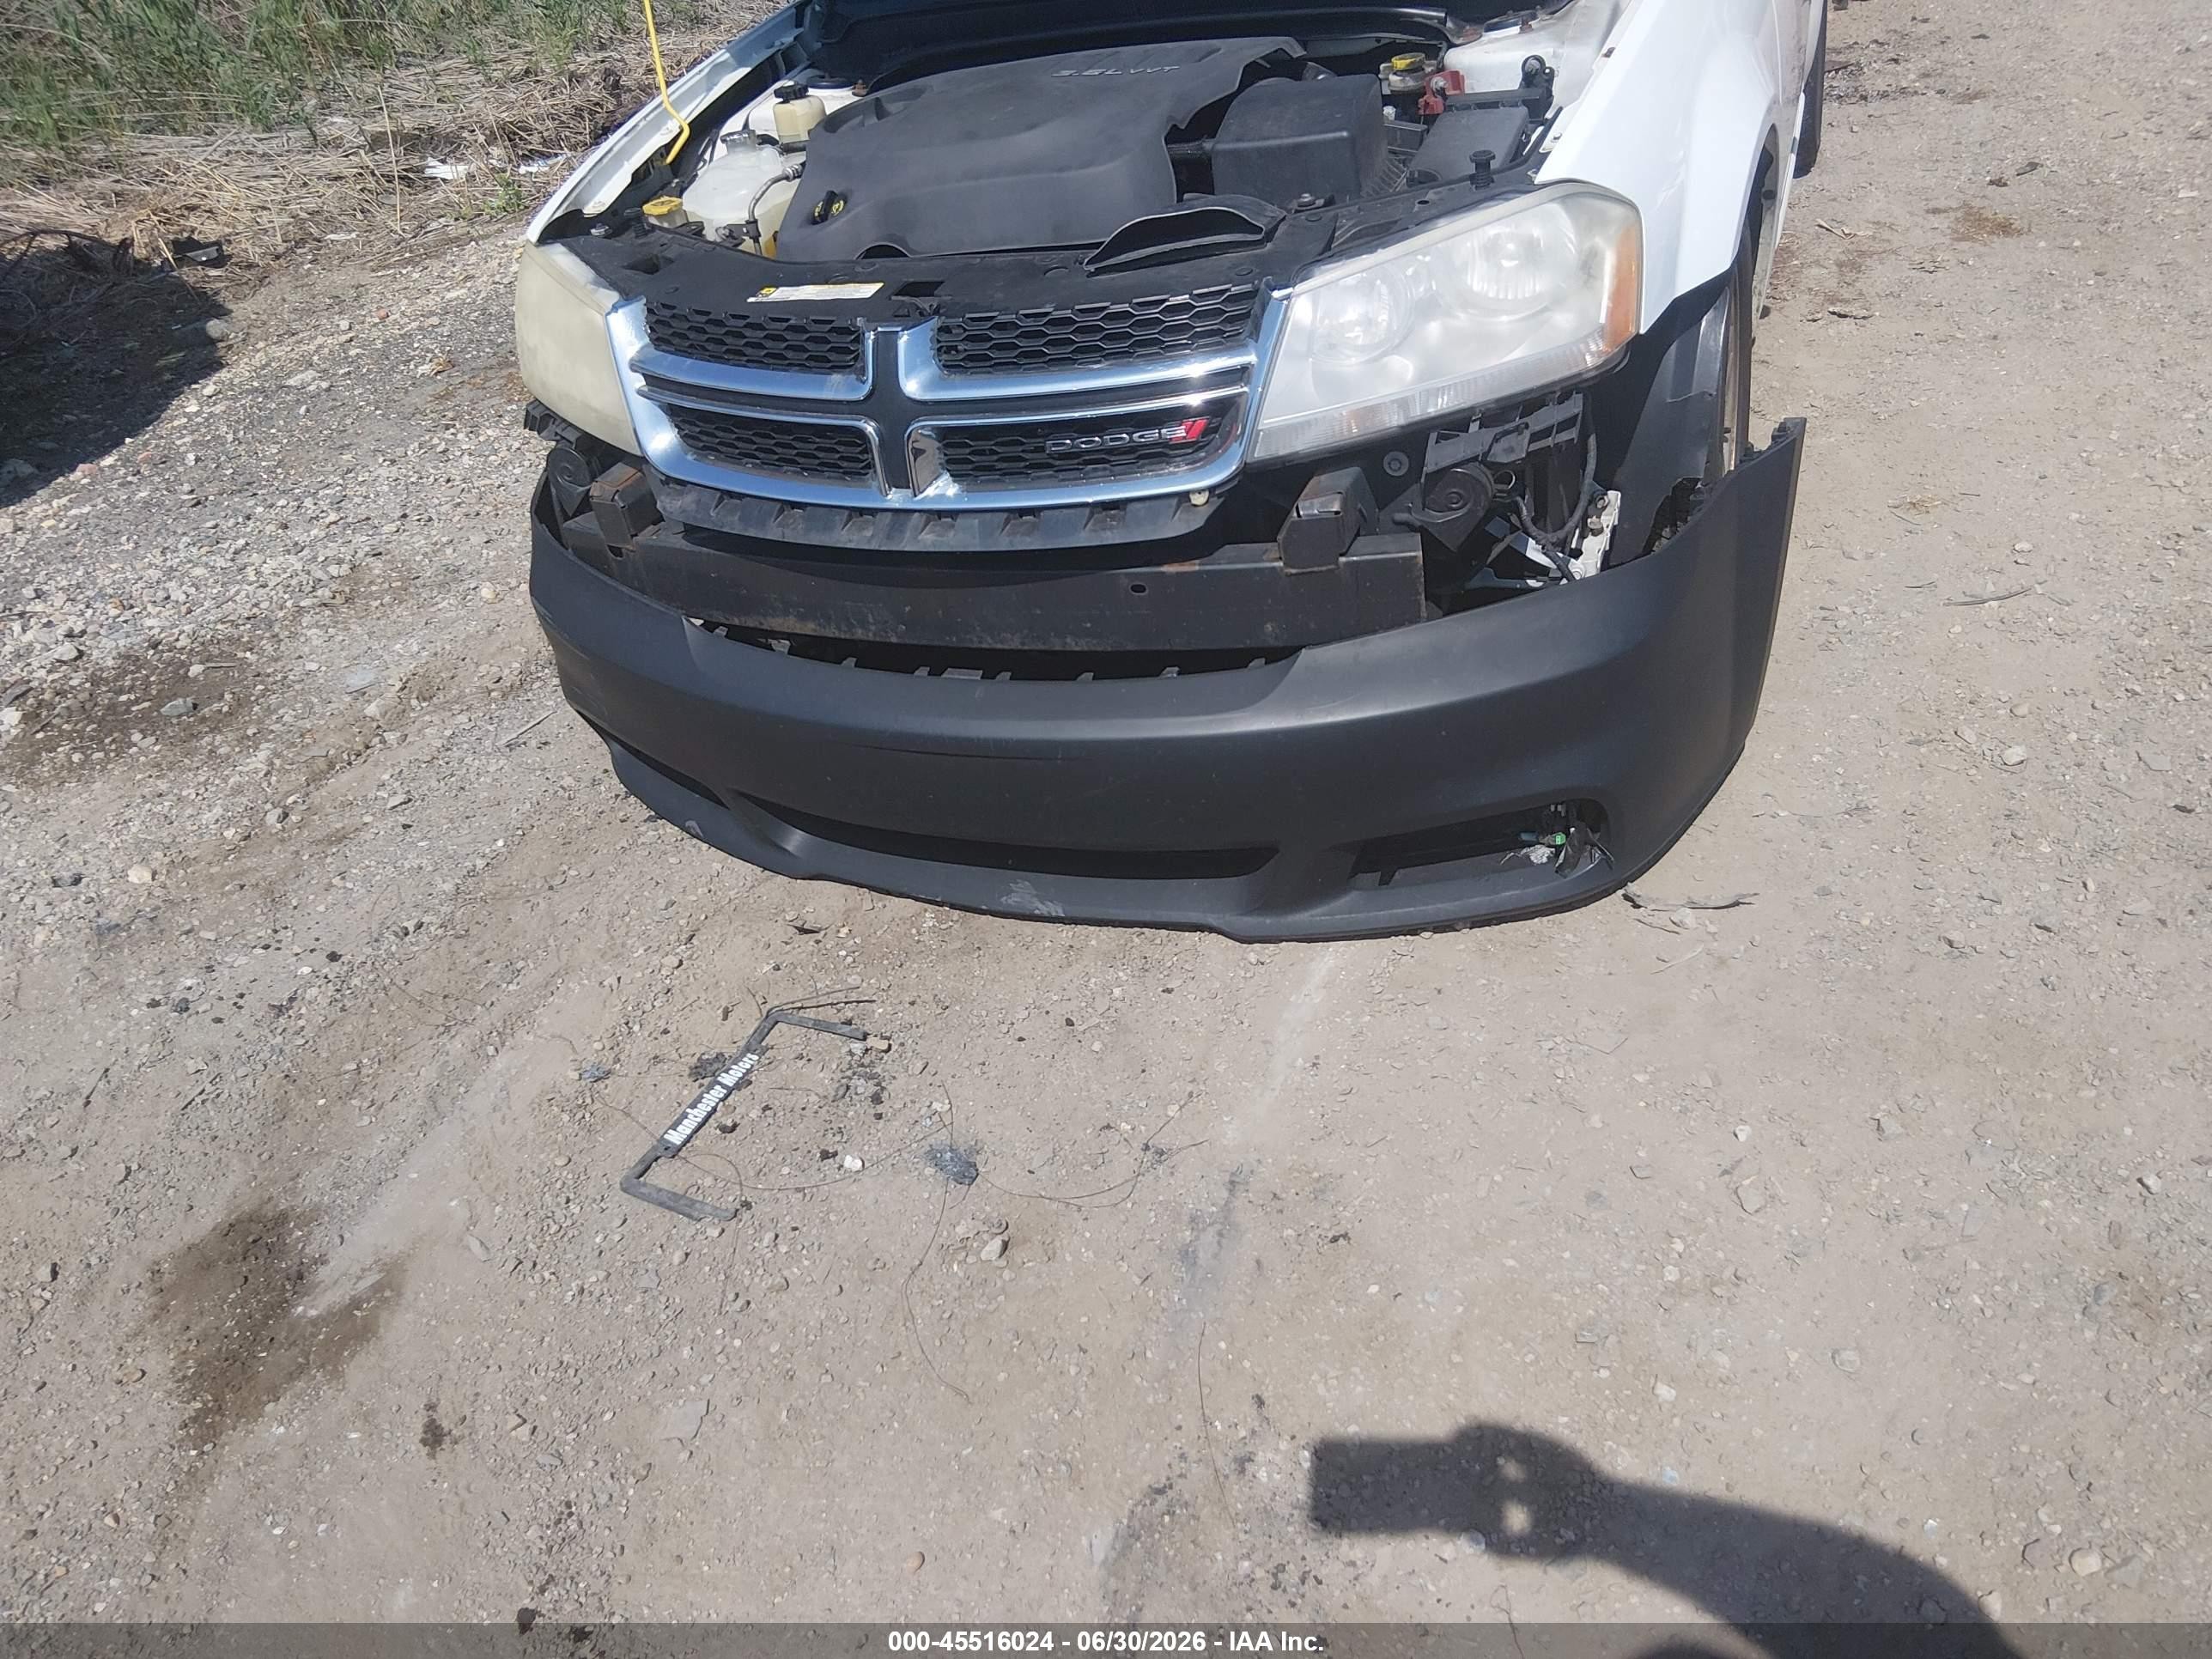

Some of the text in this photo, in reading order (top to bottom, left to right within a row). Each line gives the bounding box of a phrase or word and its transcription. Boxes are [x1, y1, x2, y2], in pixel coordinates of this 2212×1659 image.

[1129, 65, 1181, 75] VVT
[1045, 425, 1187, 454] DODGE
[663, 1053, 760, 1145] Manchester Motors
